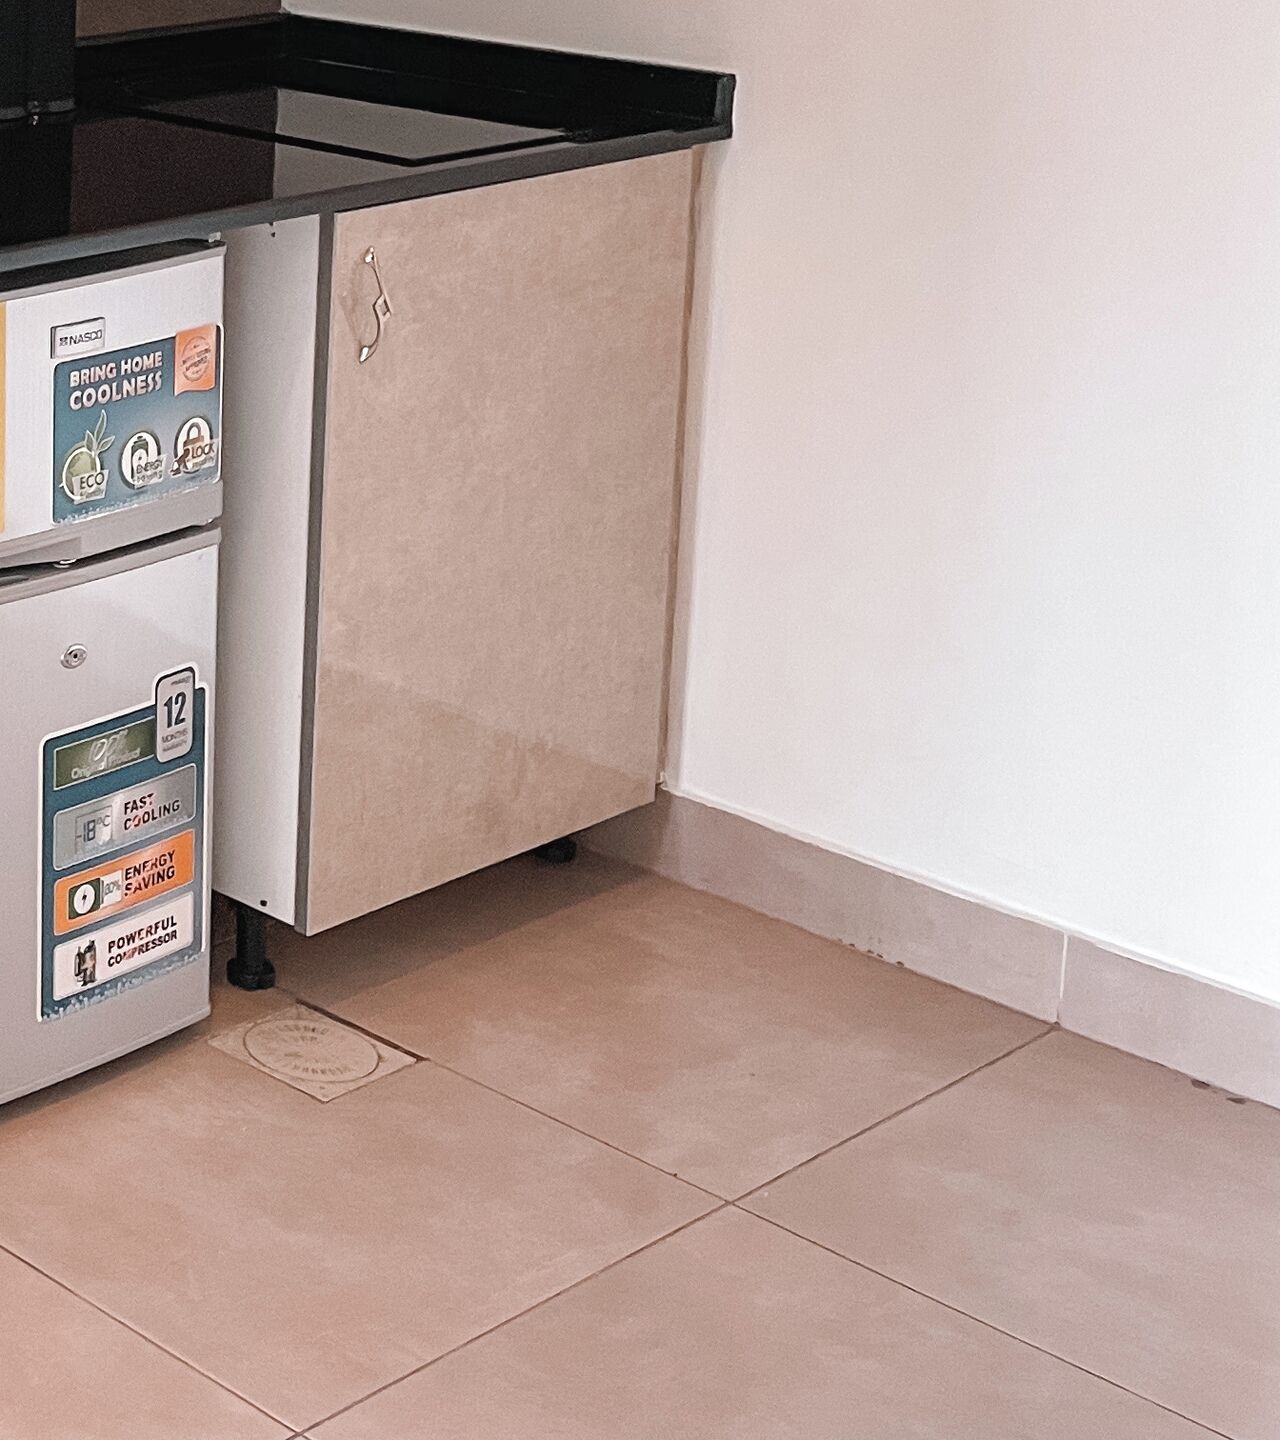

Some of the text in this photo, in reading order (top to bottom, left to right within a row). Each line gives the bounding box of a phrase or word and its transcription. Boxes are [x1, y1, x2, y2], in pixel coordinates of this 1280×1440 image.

[69, 328, 103, 346] NASCO
[69, 362, 117, 387] BRING
[121, 351, 163, 375] HOME
[69, 370, 163, 410] COOLNESS
[136, 459, 163, 474] ENERGY
[191, 442, 215, 459] LOCK
[79, 472, 105, 490] ECO
[163, 691, 187, 729] 12
[123, 792, 155, 816] FAST
[123, 799, 181, 831] COOLING
[124, 849, 176, 882] ENERGY
[124, 865, 176, 897] SAVING
[107, 915, 178, 954] POWERFUL
[107, 929, 178, 968] COMPRESSOR
